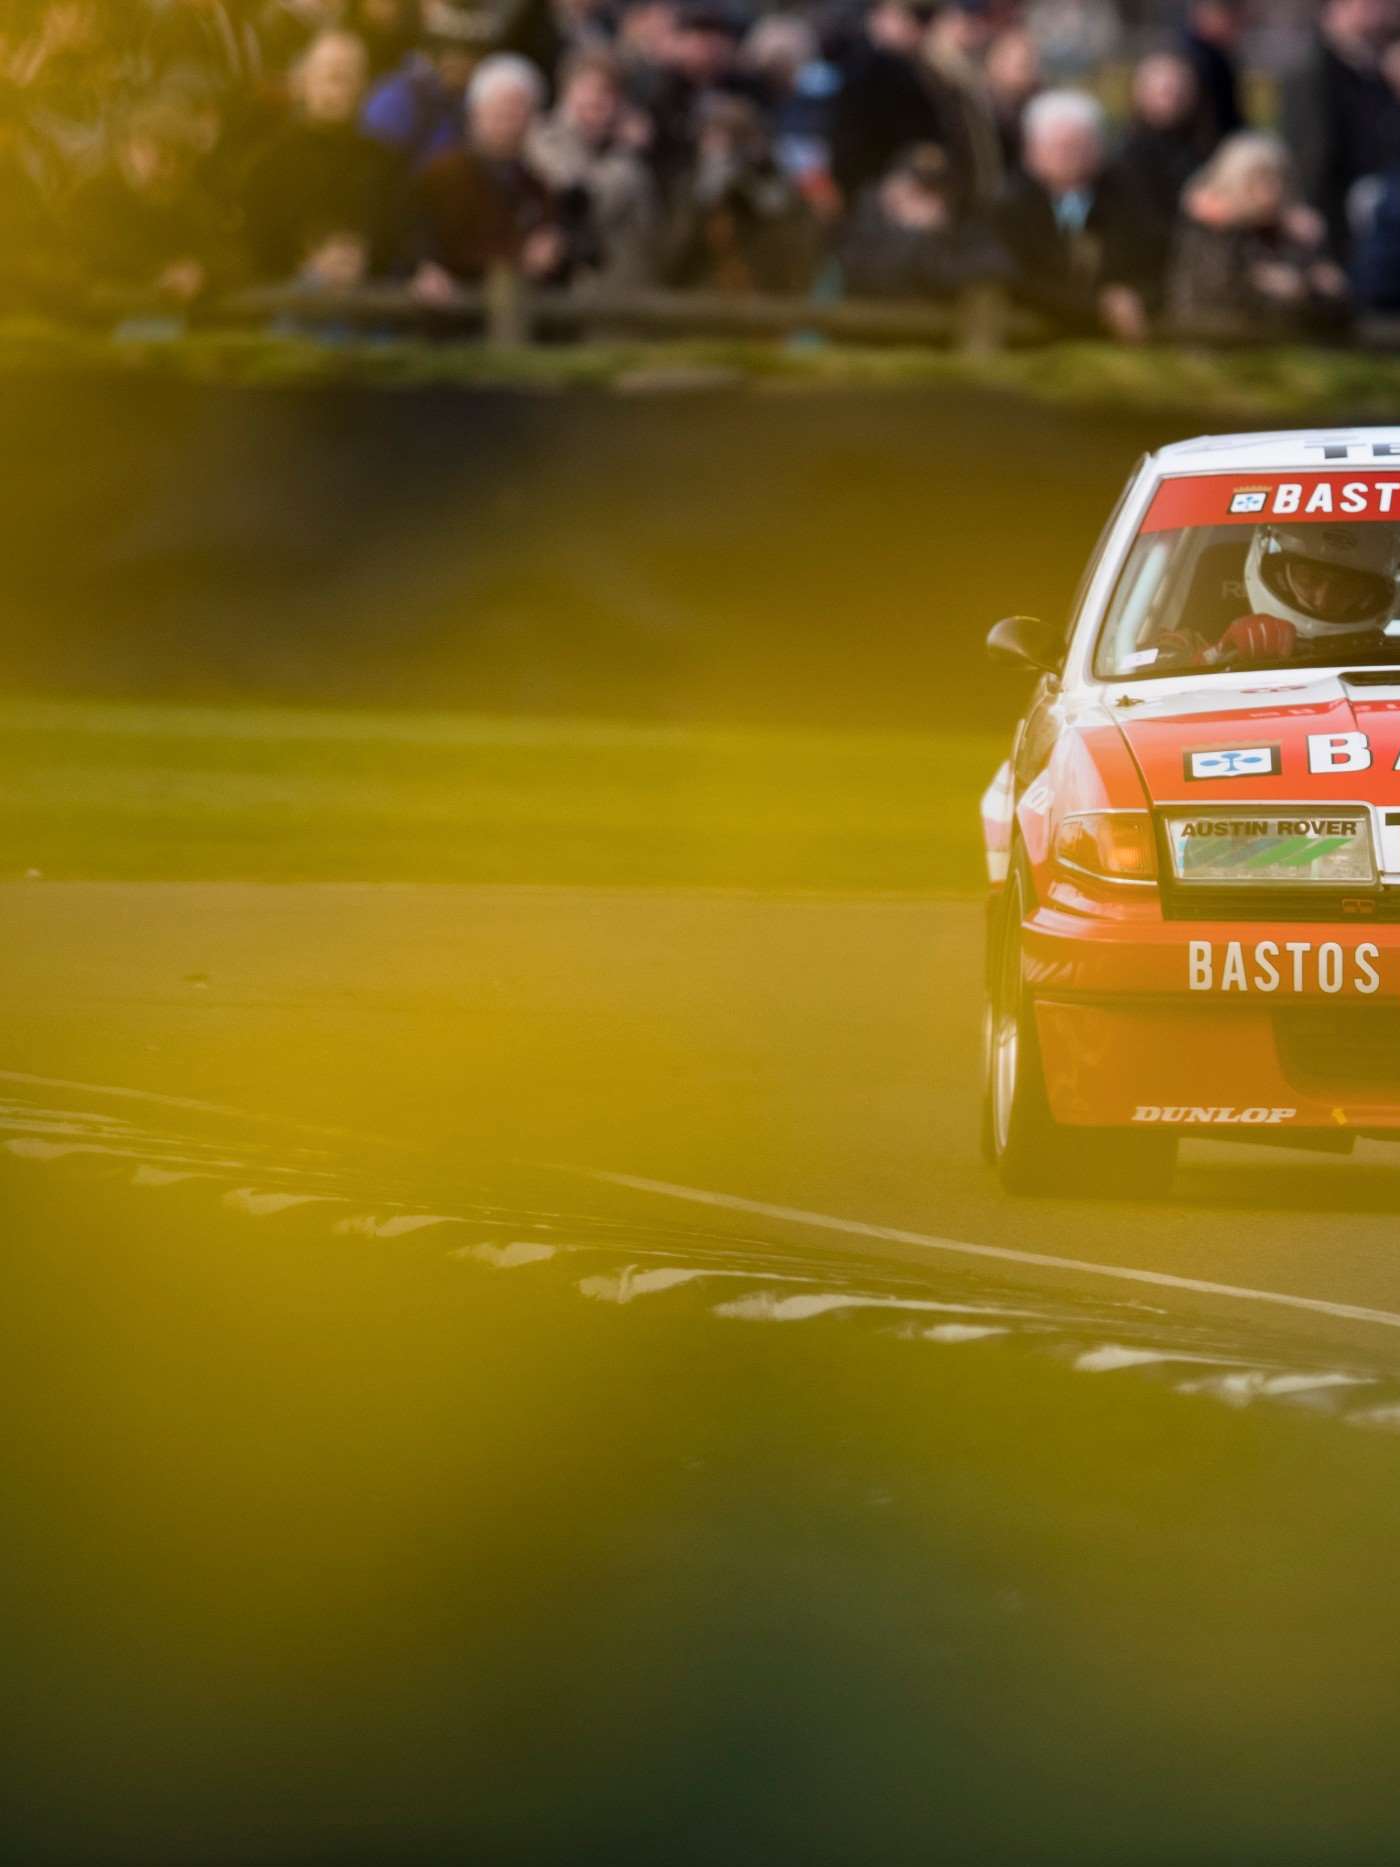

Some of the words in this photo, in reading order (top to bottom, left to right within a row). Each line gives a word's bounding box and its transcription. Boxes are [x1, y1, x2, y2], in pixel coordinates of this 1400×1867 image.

[1181, 820, 1270, 837] AUSTIN
[1276, 819, 1358, 836] ROVER
[1188, 940, 1381, 994] BASTOS
[1131, 1105, 1297, 1124] DUNLOP
